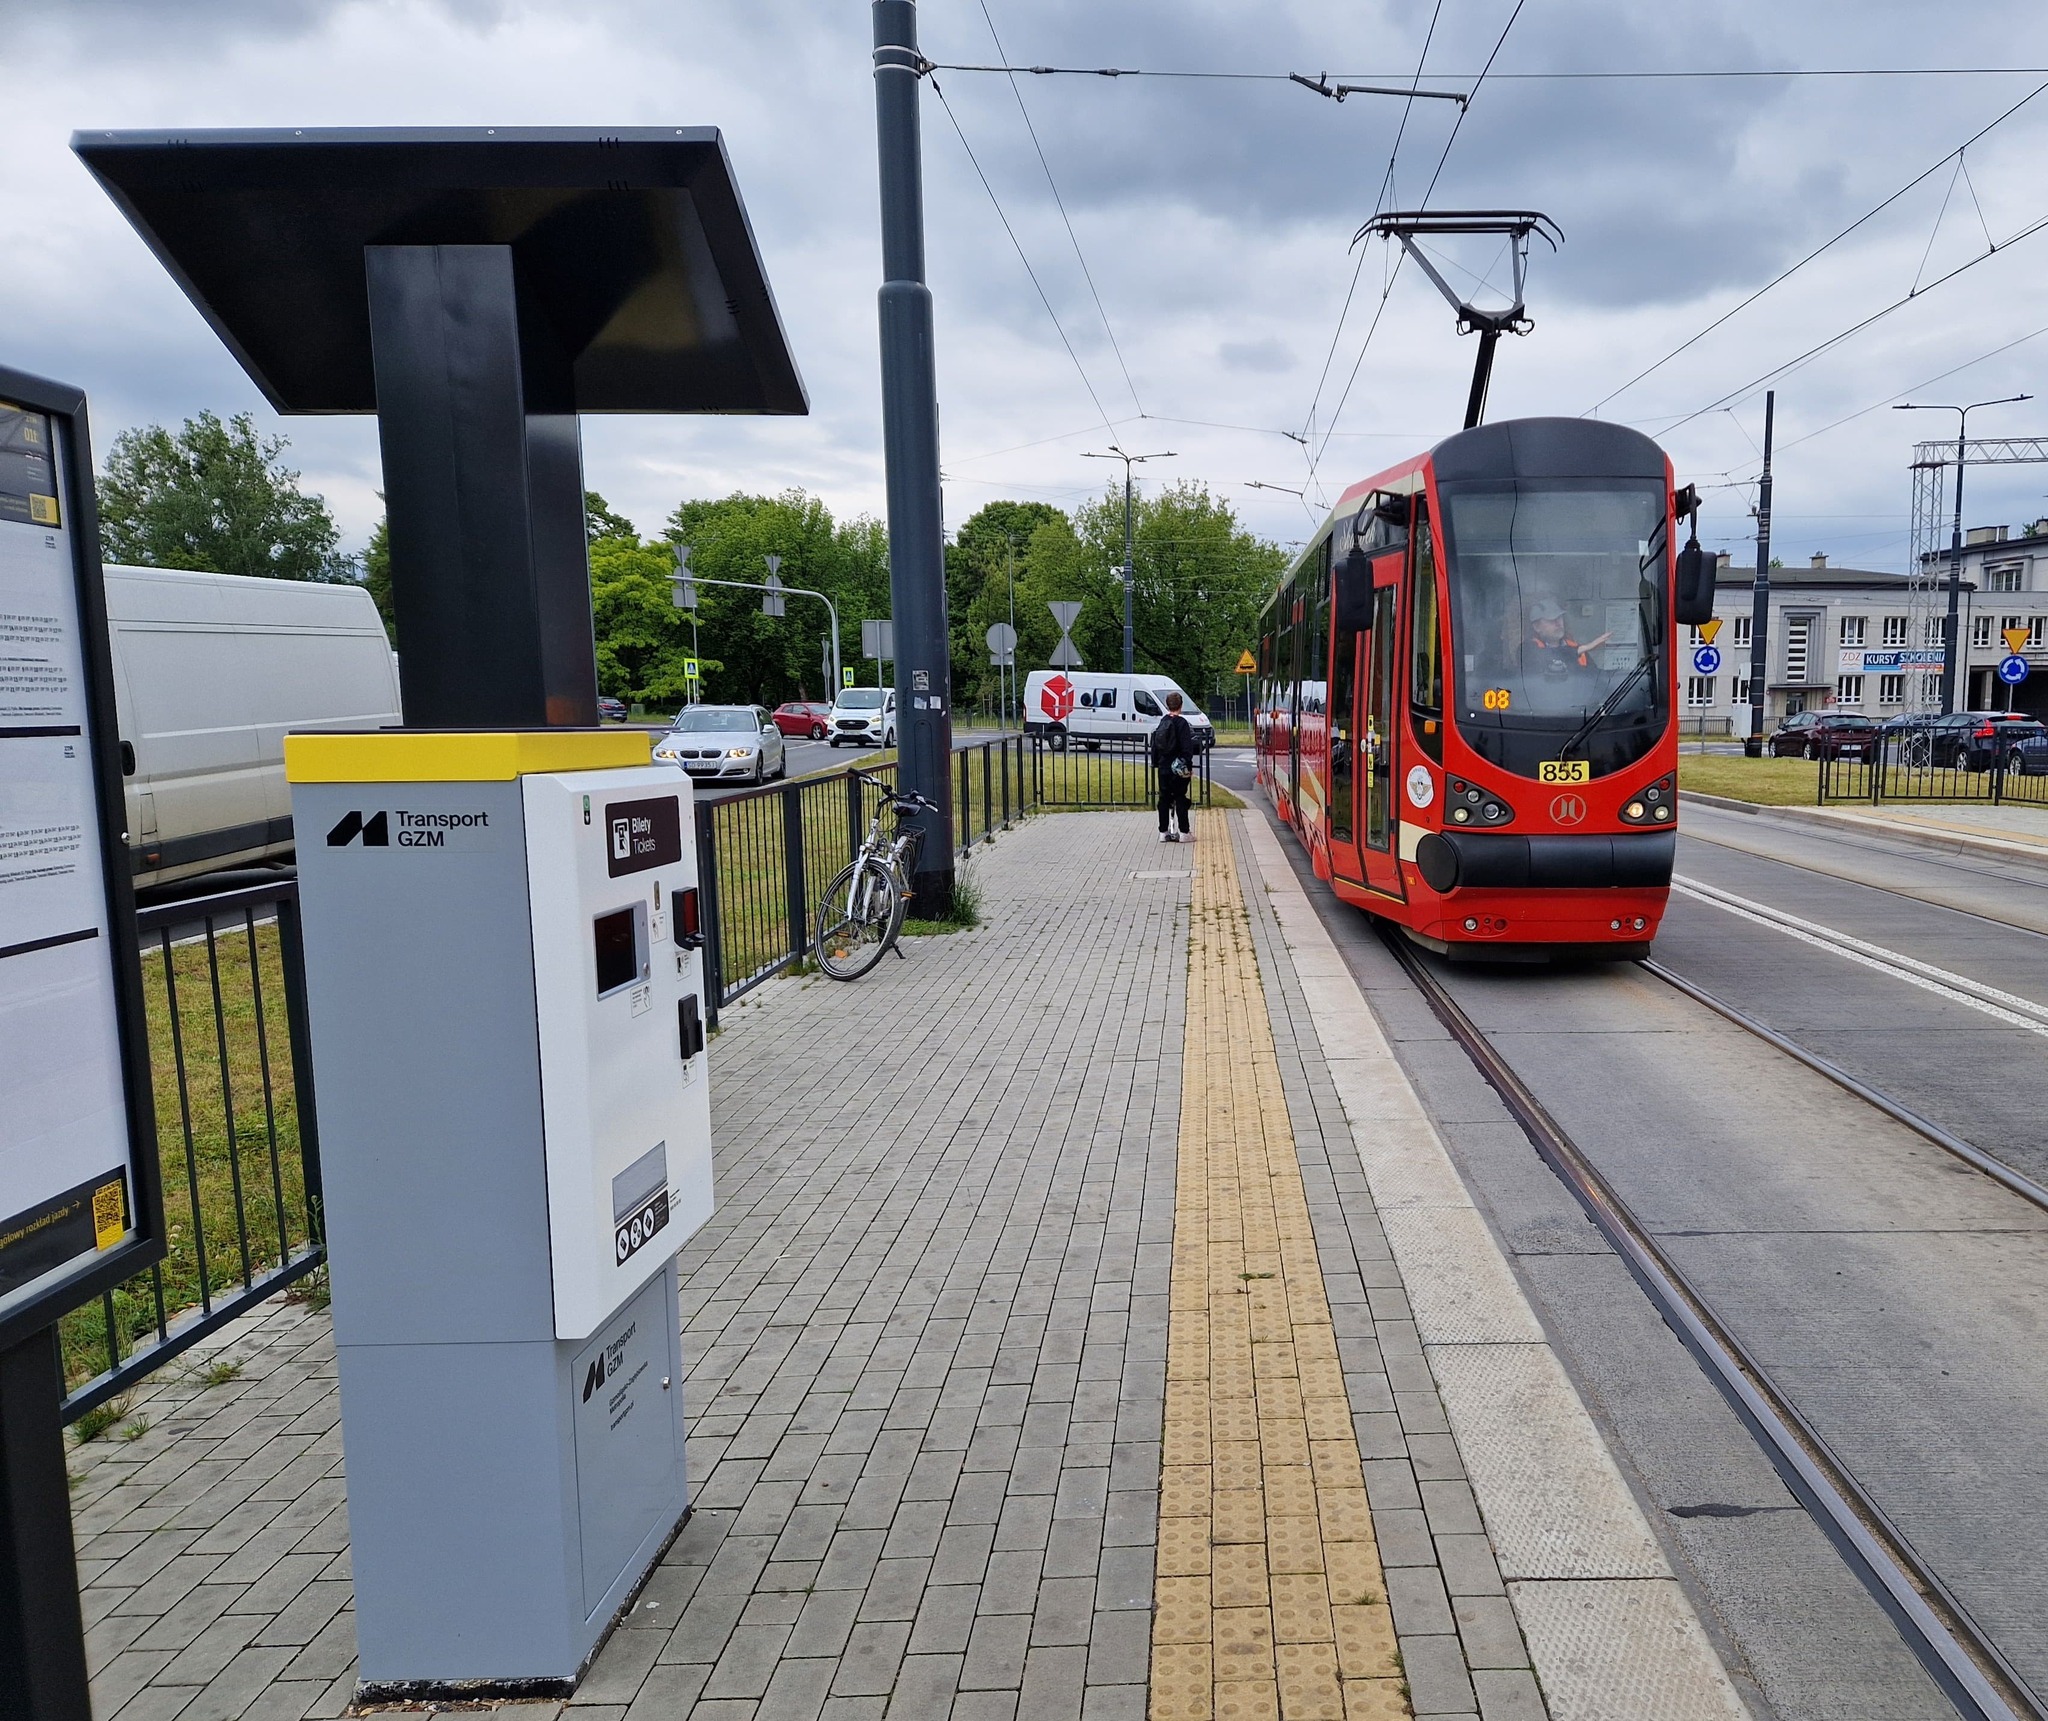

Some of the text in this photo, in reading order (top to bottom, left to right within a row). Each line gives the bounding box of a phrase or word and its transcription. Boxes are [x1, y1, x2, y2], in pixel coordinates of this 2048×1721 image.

[1866, 654, 1896, 665] KURSY
[1484, 690, 1510, 709] 08
[1543, 764, 1583, 782] 855
[395, 810, 490, 829] Transport
[631, 816, 652, 834] Bilety
[397, 831, 445, 848] GZM
[632, 840, 656, 855] Tickets
[52, 1207, 69, 1223] jazdy
[606, 1321, 637, 1360] Transport
[607, 1350, 624, 1378] GZM
